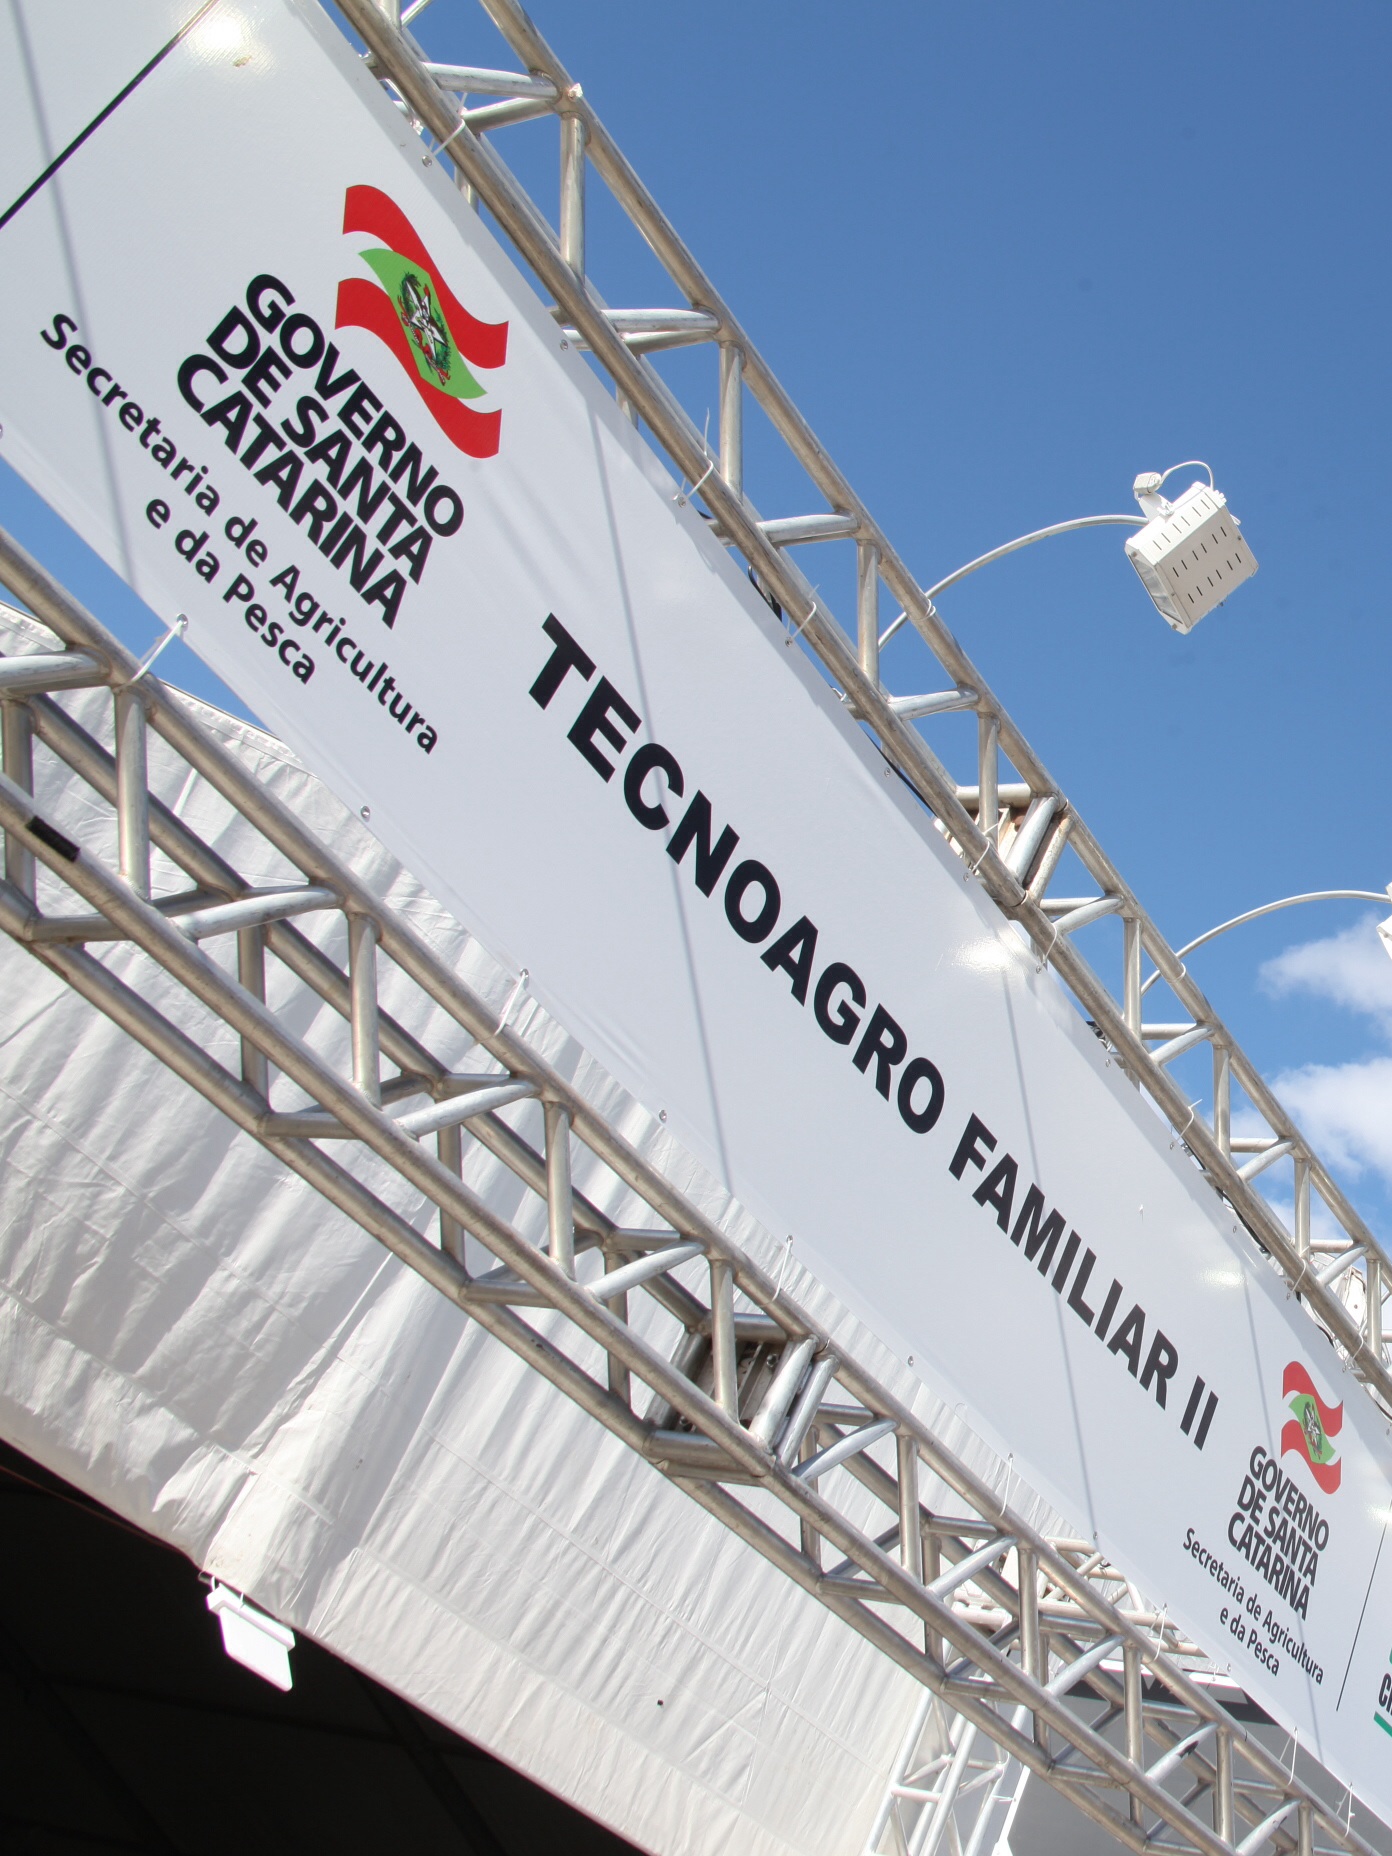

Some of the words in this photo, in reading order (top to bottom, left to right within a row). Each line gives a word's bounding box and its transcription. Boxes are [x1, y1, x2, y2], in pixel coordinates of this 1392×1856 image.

[176, 353, 408, 630] CATARINA
[205, 305, 294, 410] DE
[280, 395, 434, 585] SANTA
[245, 273, 464, 538] GOVERNO
[39, 313, 220, 517] Secretaria
[224, 516, 268, 568] de
[268, 564, 438, 755] Agricultura
[145, 498, 171, 530] e
[174, 529, 220, 584] da
[222, 572, 315, 685] Pesca
[528, 612, 945, 1135] TECNOAGRO
[948, 1112, 1179, 1411] FAMILIAR
[1179, 1375, 1219, 1451] II
[1227, 1511, 1310, 1622] CATARINA
[1236, 1474, 1267, 1527] DE
[1263, 1505, 1319, 1587] SANTA
[1249, 1445, 1330, 1552] GOVERNO
[1182, 1527, 1245, 1605] Secretaria
[1245, 1593, 1263, 1623] de
[1261, 1609, 1324, 1685] Agricultura
[1219, 1607, 1229, 1625] e
[1229, 1614, 1246, 1643] da
[1246, 1628, 1280, 1677] Pesca
